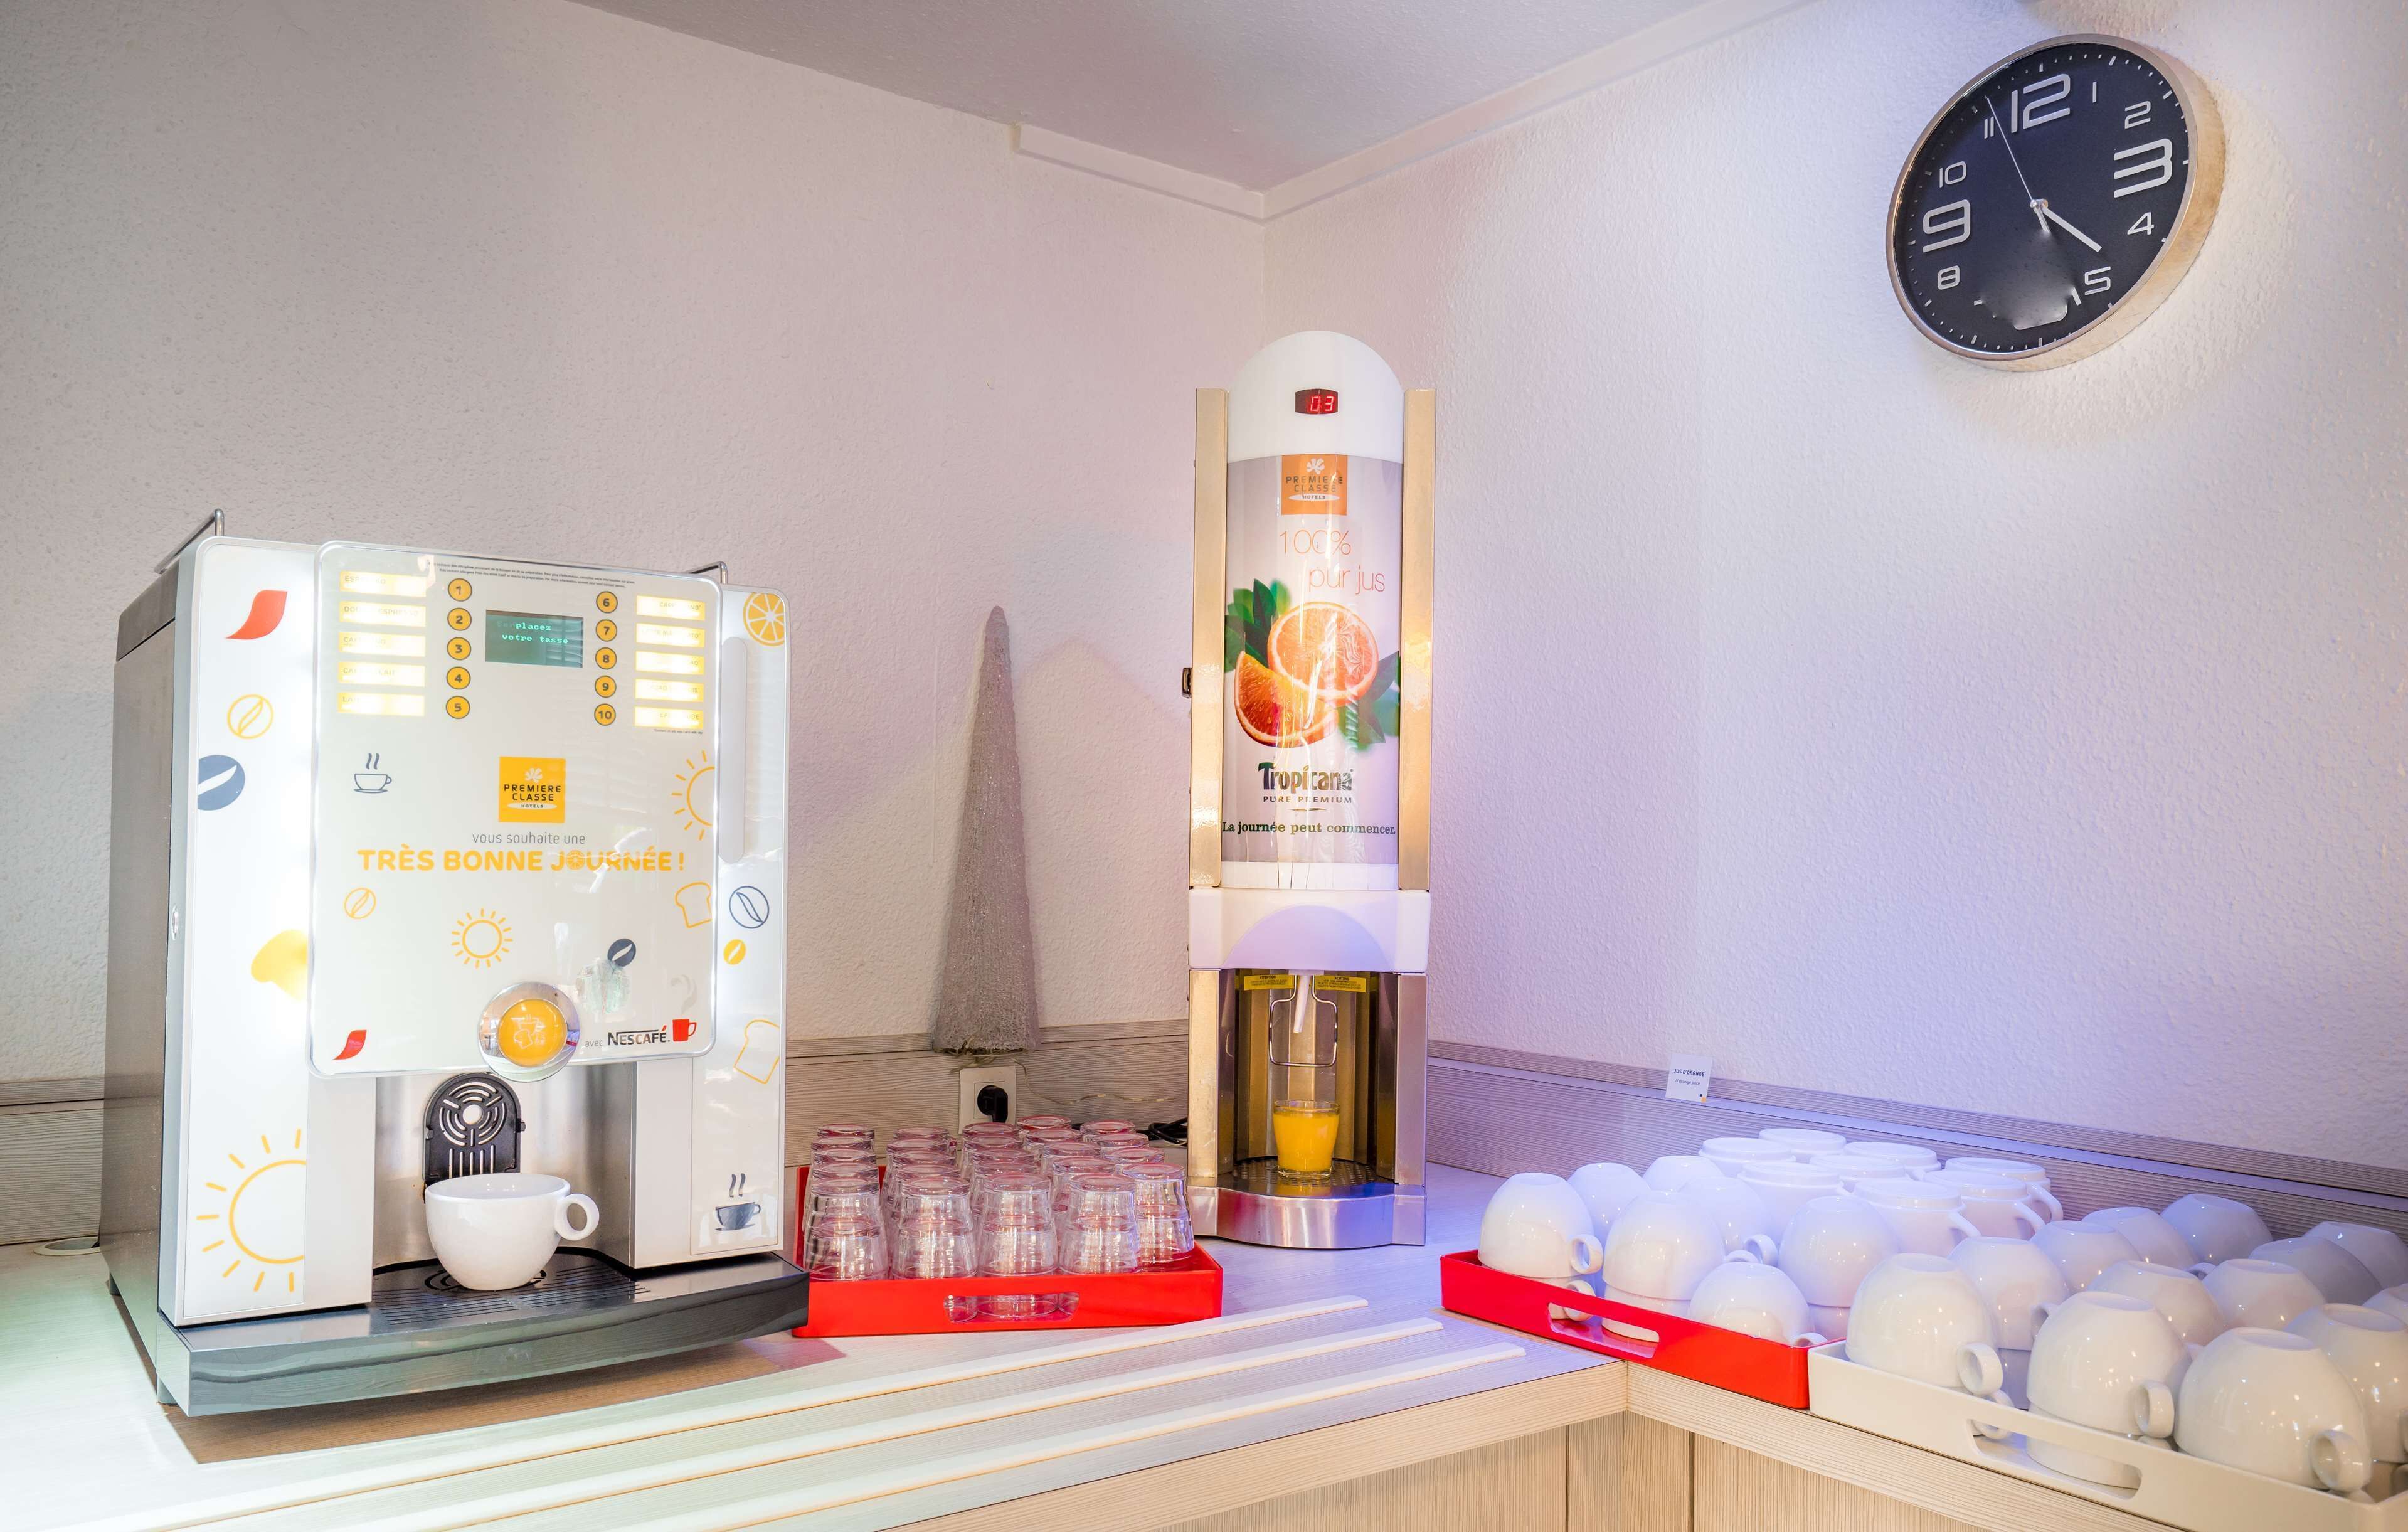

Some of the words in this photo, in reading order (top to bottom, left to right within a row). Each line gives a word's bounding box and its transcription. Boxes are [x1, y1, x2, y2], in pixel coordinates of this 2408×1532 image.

[2092, 82, 2097, 103] 1
[2011, 73, 2071, 133] 12
[2124, 101, 2151, 129] 2
[1984, 117, 1995, 139] 11
[1939, 161, 1966, 188] 10
[2114, 138, 2172, 198] 3
[1923, 199, 1971, 253] 9
[2127, 211, 2155, 235] 4
[1937, 265, 1960, 290] 8
[2084, 265, 2111, 295] 5
[1310, 396, 1334, 412] 03
[1294, 484, 1336, 492] CLASSE
[1279, 530, 1351, 555] 100%
[1309, 567, 1350, 592] pur
[1355, 565, 1386, 595] jus
[456, 585, 462, 595] 1
[603, 598, 610, 607] 6
[455, 615, 463, 625] 2
[516, 622, 552, 631] placez
[603, 626, 610, 636] 7
[502, 634, 533, 642] votre
[539, 636, 569, 644] tasse
[455, 644, 462, 654] 3
[603, 654, 610, 664] 8
[454, 674, 462, 683] 4
[602, 683, 609, 691] 9
[454, 703, 462, 713] 5
[598, 710, 612, 720] 10
[1258, 762, 1352, 794] Tropicana
[504, 784, 561, 793] PREMIERE
[512, 793, 554, 801] CLASSE
[1222, 822, 1235, 832] La
[1238, 821, 1285, 834] journée
[1290, 823, 1322, 835] peut
[1327, 824, 1396, 834] commencer.
[472, 832, 502, 844] vous
[506, 831, 560, 844] souhaite
[563, 834, 586, 844] une
[357, 844, 435, 872] TRÈS
[443, 850, 543, 872] BONNE
[551, 845, 672, 872] JOURNÉE
[585, 1039, 604, 1048] avec
